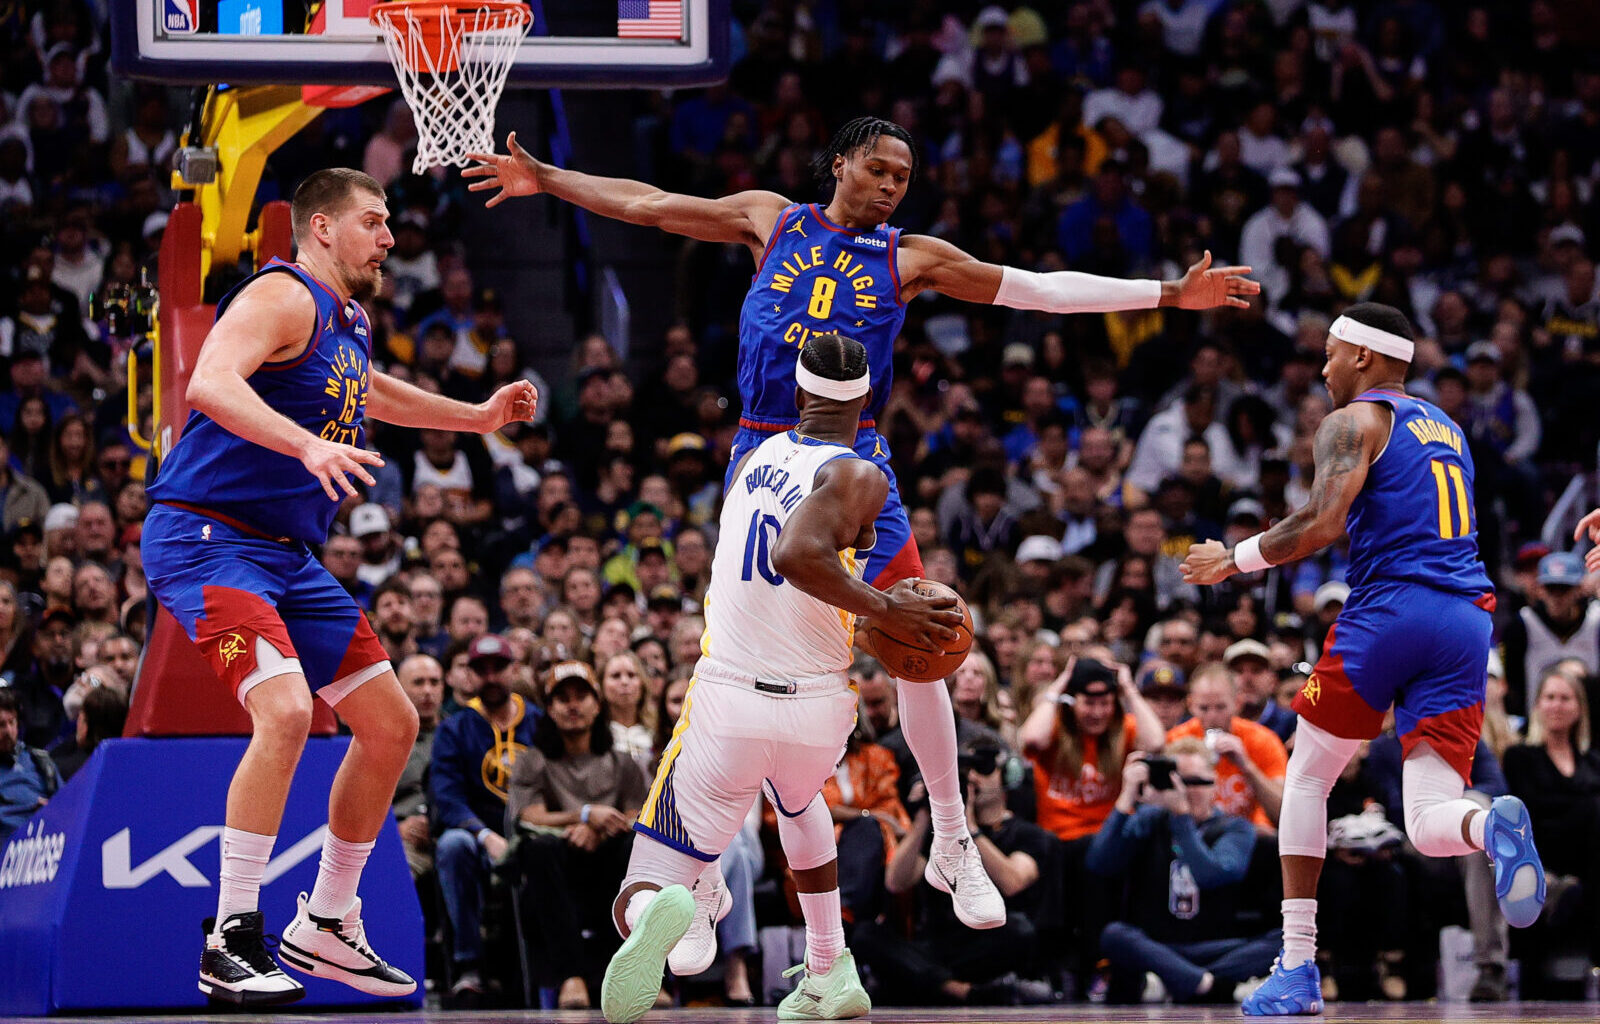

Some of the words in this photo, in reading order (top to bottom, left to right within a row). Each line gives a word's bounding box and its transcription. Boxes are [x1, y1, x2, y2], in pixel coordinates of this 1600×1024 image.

[168, 13, 186, 29] NBA
[854, 236, 887, 248] ibotta
[770, 245, 825, 293] MILE
[832, 250, 877, 309] HIGH
[807, 276, 837, 319] 8
[784, 322, 838, 350] CI
[324, 345, 349, 399] MILE
[347, 347, 368, 406] HIGH
[338, 377, 359, 424] 15
[319, 420, 359, 448] CITY
[1406, 418, 1462, 456] BROWN
[745, 464, 790, 497] BUTLER
[780, 484, 803, 514] III
[1430, 459, 1470, 540] 11
[741, 508, 784, 586] 10
[0, 818, 66, 890] coinbase
